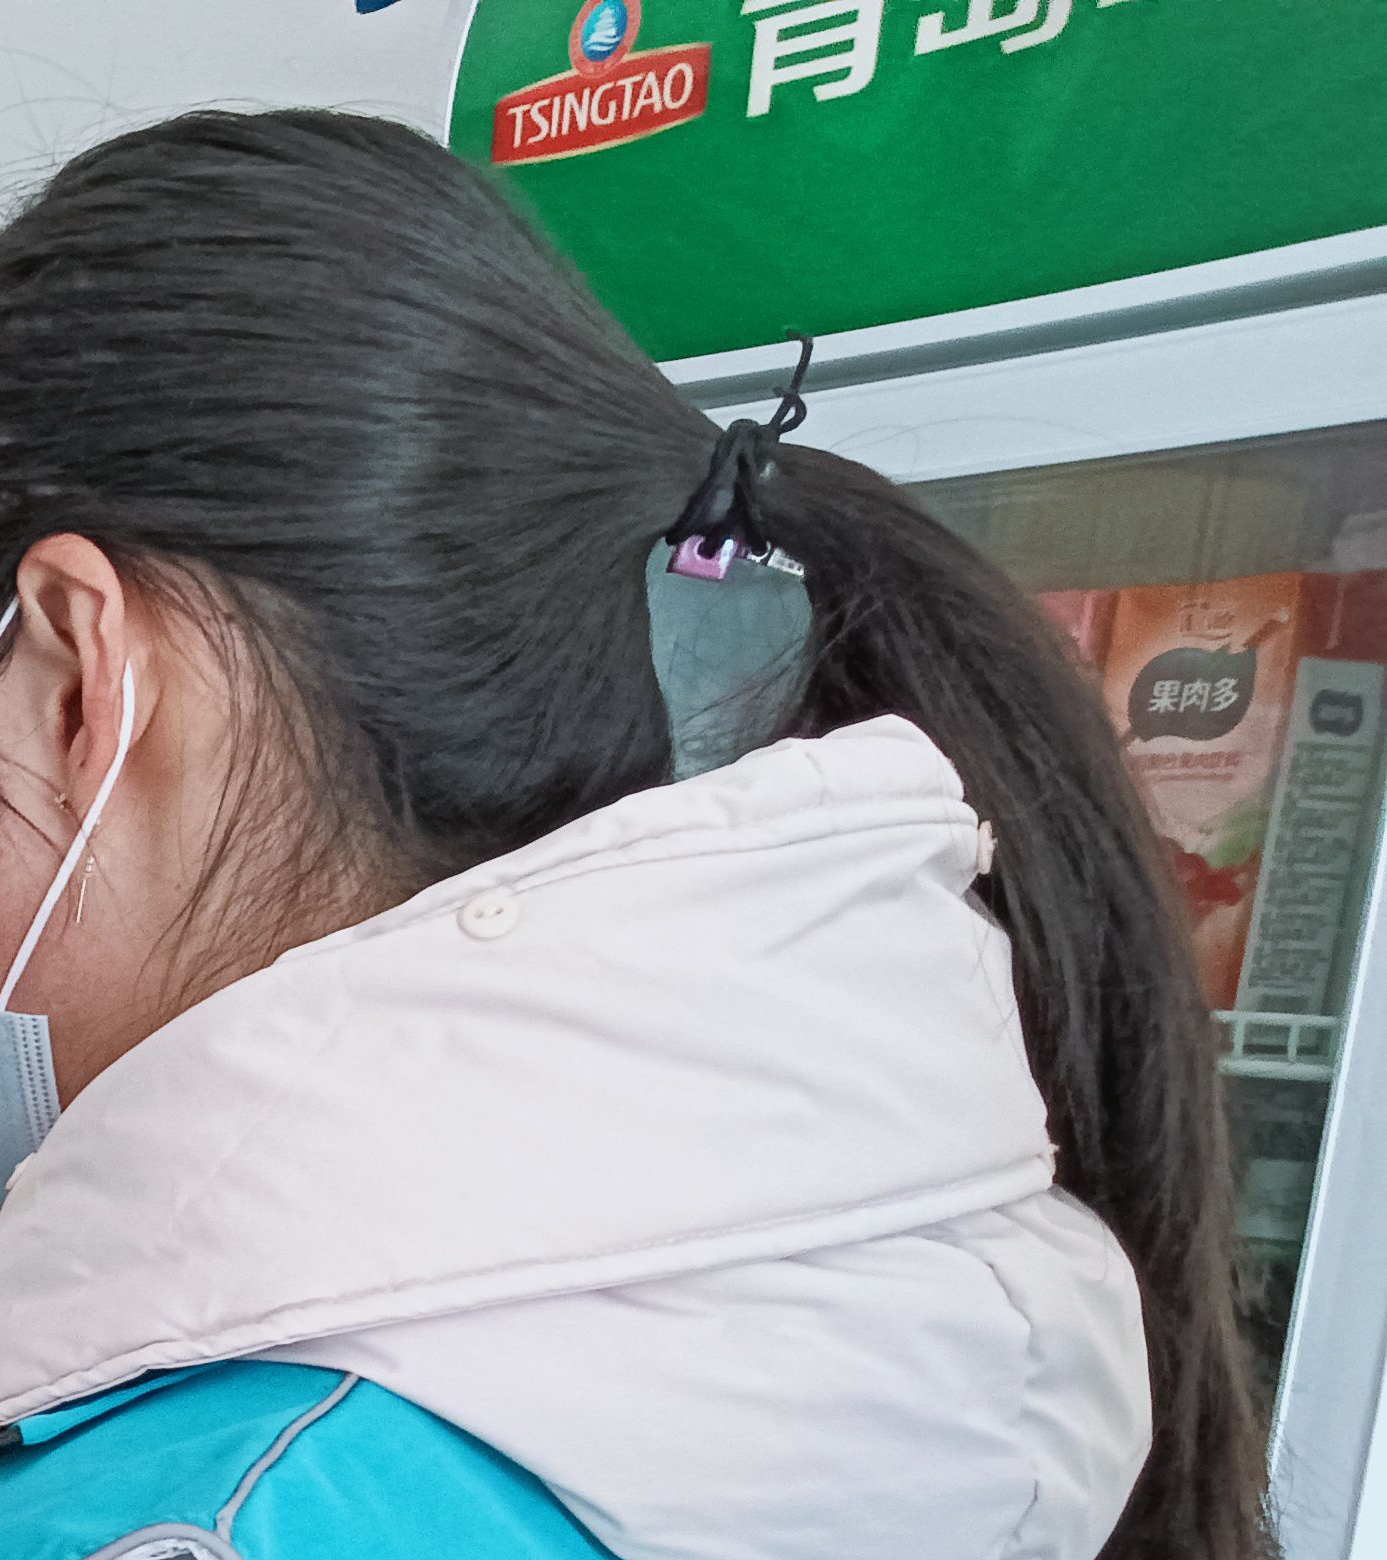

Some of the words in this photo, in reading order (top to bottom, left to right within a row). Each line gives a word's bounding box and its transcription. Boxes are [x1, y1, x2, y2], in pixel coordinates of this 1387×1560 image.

[507, 62, 694, 148] TSINGTAO
[1148, 678, 1240, 713] 果肉多
